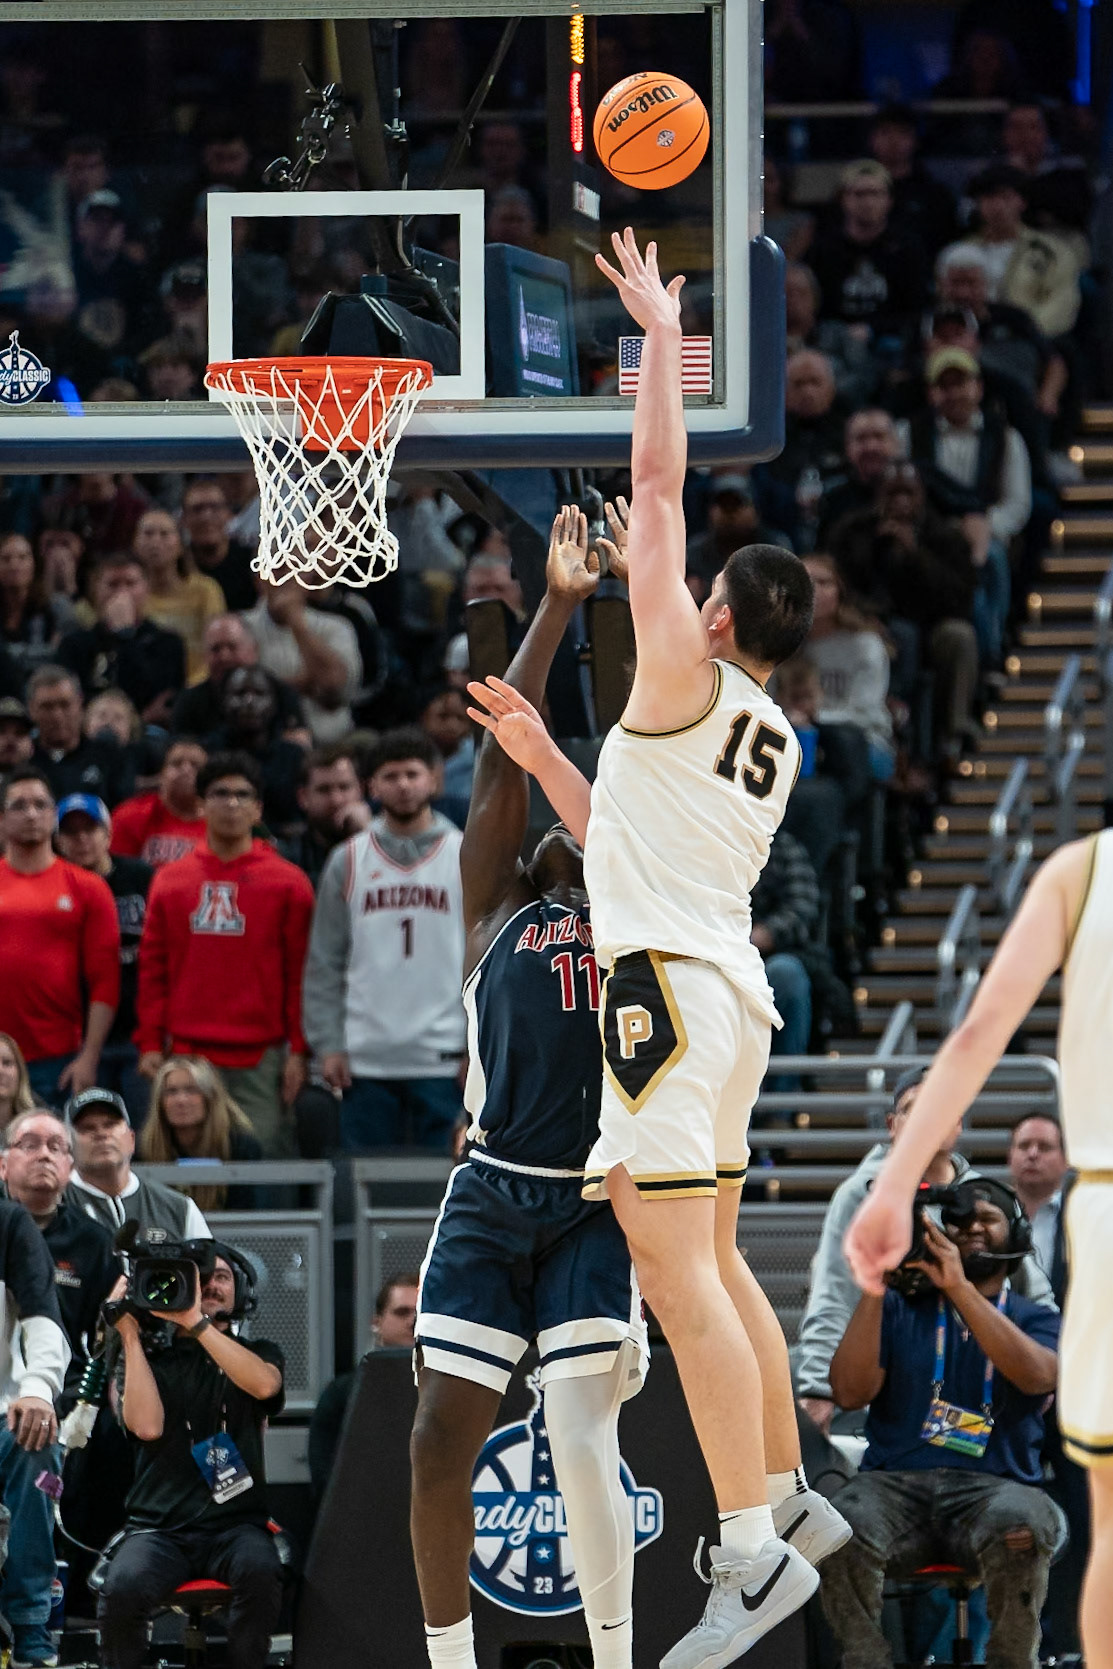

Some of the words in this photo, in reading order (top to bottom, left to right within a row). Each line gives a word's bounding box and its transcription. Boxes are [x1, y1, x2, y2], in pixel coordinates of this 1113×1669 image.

[608, 85, 679, 132] Wilson
[713, 709, 787, 801] 15
[364, 886, 450, 915] ARIZONA
[401, 918, 415, 959] 1
[551, 952, 600, 1011] 11
[616, 1004, 653, 1059] P
[534, 1576, 553, 1594] 23
